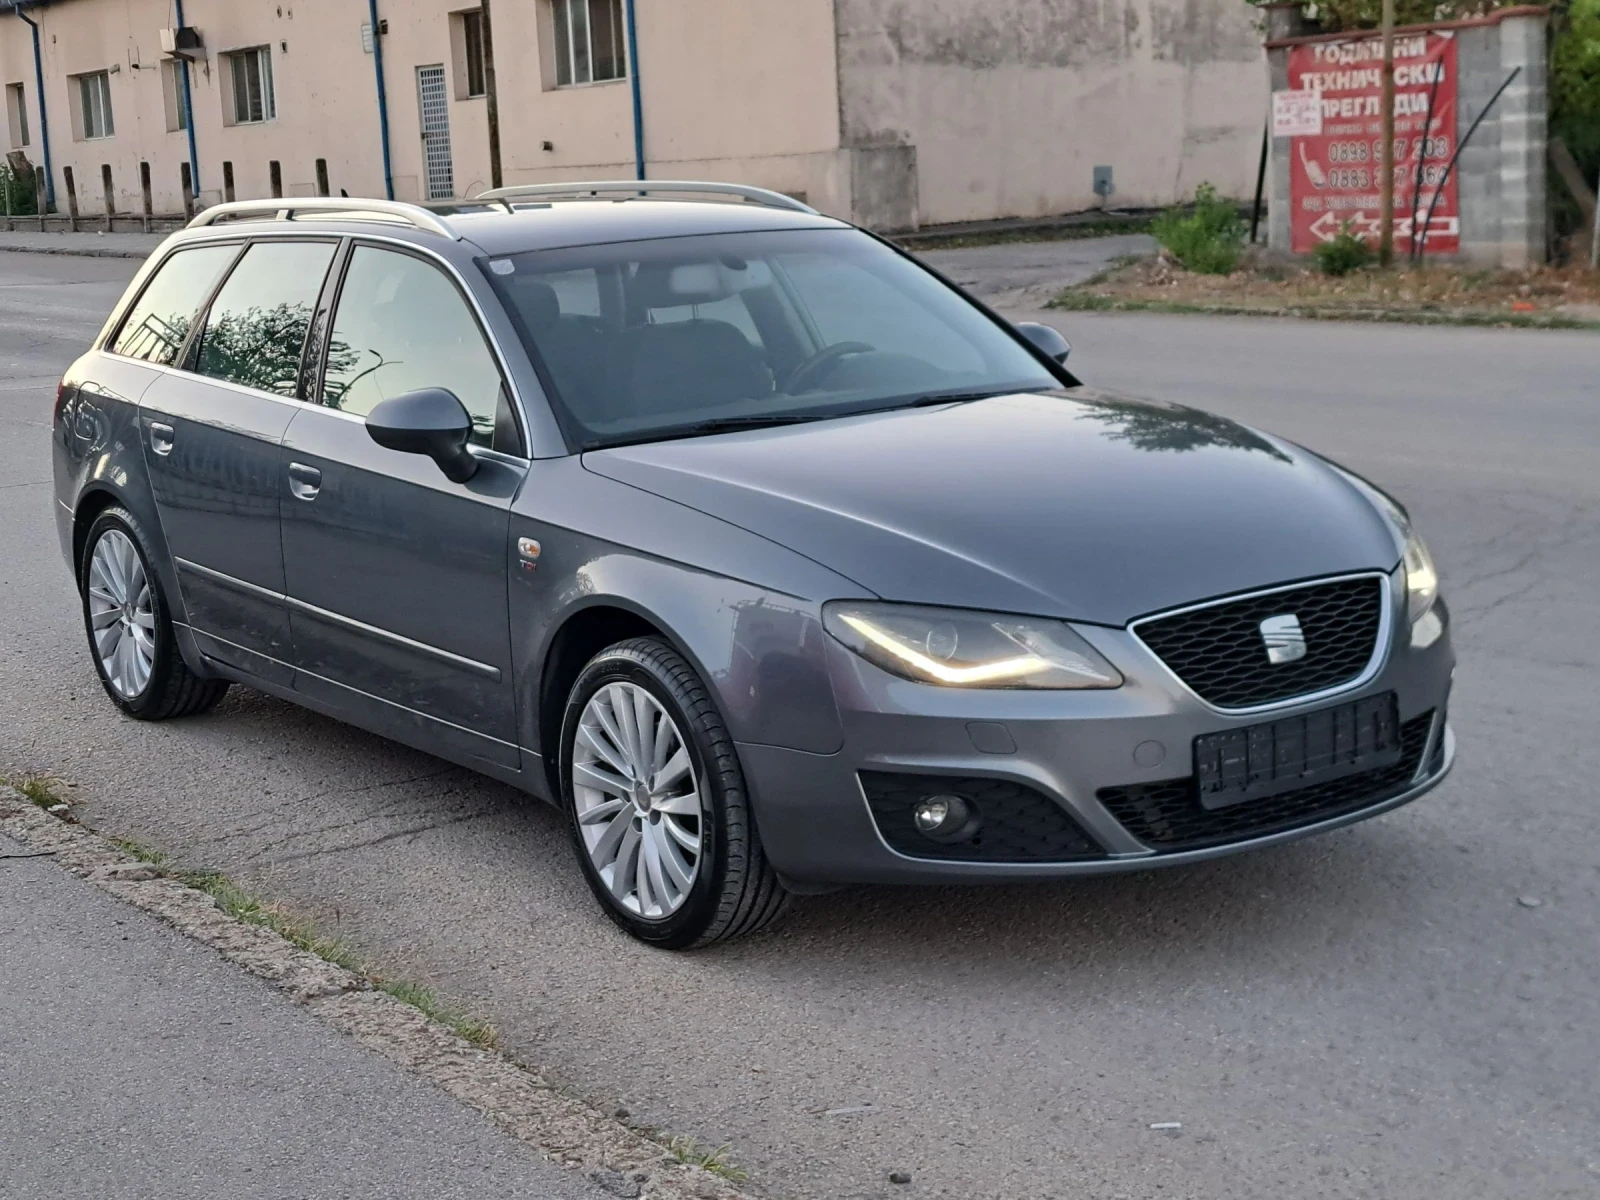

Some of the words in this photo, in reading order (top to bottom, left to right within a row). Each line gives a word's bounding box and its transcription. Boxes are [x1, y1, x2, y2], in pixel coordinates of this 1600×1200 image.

[1300, 62, 1445, 91] ТЕХНИЧСКИ
[1320, 92, 1429, 118] ПРЕГЛДИ
[1328, 141, 1370, 163] 0898
